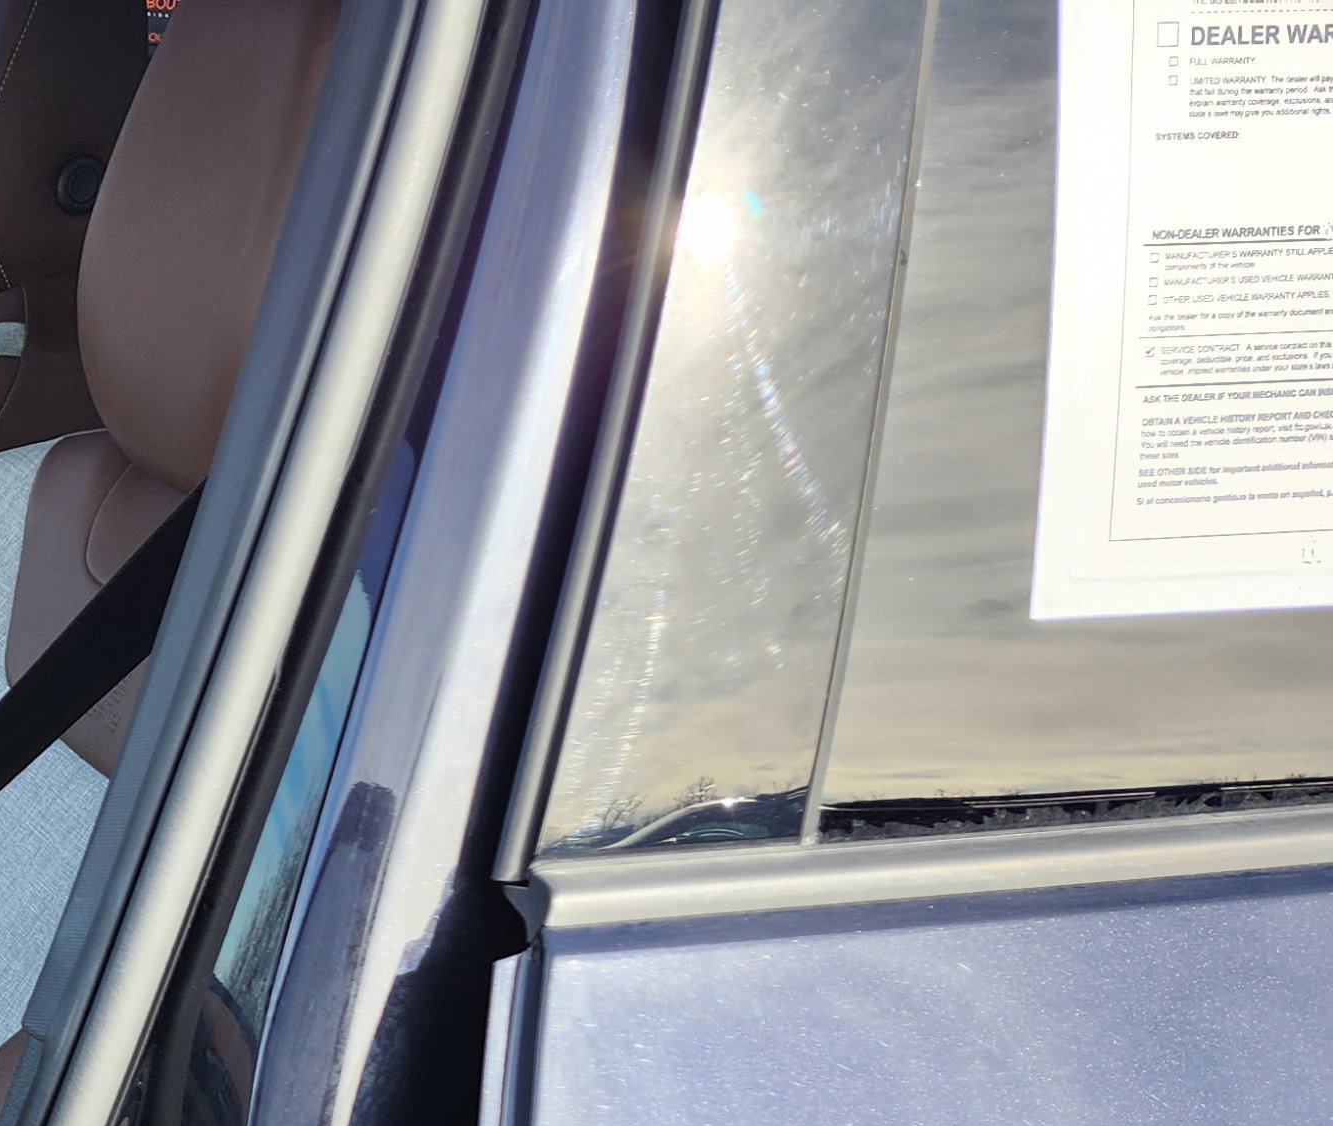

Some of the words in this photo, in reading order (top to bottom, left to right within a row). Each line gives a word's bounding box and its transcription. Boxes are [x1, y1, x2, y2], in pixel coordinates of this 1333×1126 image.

[146, 0, 180, 10] BOU
[1191, 25, 1280, 45] DEALER
[1217, 88, 1238, 96] during
[1255, 87, 1283, 95] warranty
[1216, 99, 1245, 107] warranty
[1231, 110, 1243, 118] may
[1245, 110, 1259, 118] give
[1262, 110, 1273, 118] you
[1156, 132, 1195, 140] SYSTEMS
[1152, 229, 1219, 239] NON-DEALER
[1222, 226, 1294, 238] WARRANTIES
[1298, 225, 1320, 235] FOR
[1240, 249, 1283, 257] WARRANTY
[1239, 276, 1259, 284] USED
[1262, 274, 1294, 282] VEHICLE
[1252, 292, 1294, 300] WARRANTY
[1182, 393, 1215, 402] DEALER
[1218, 392, 1225, 400] IF
[1228, 392, 1250, 400] YOUR
[1253, 390, 1296, 399] MECHANIC
[1299, 389, 1316, 397] CAN
[1142, 417, 1173, 426] OBTAIN
[1183, 416, 1218, 425] VEHICLE
[1221, 414, 1255, 422] HISTORY
[1258, 412, 1292, 422] REPORT
[1294, 412, 1311, 420] AND
[1138, 469, 1155, 477] SEE
[1157, 468, 1185, 477] OTHER
[1188, 467, 1207, 475] SIDE
